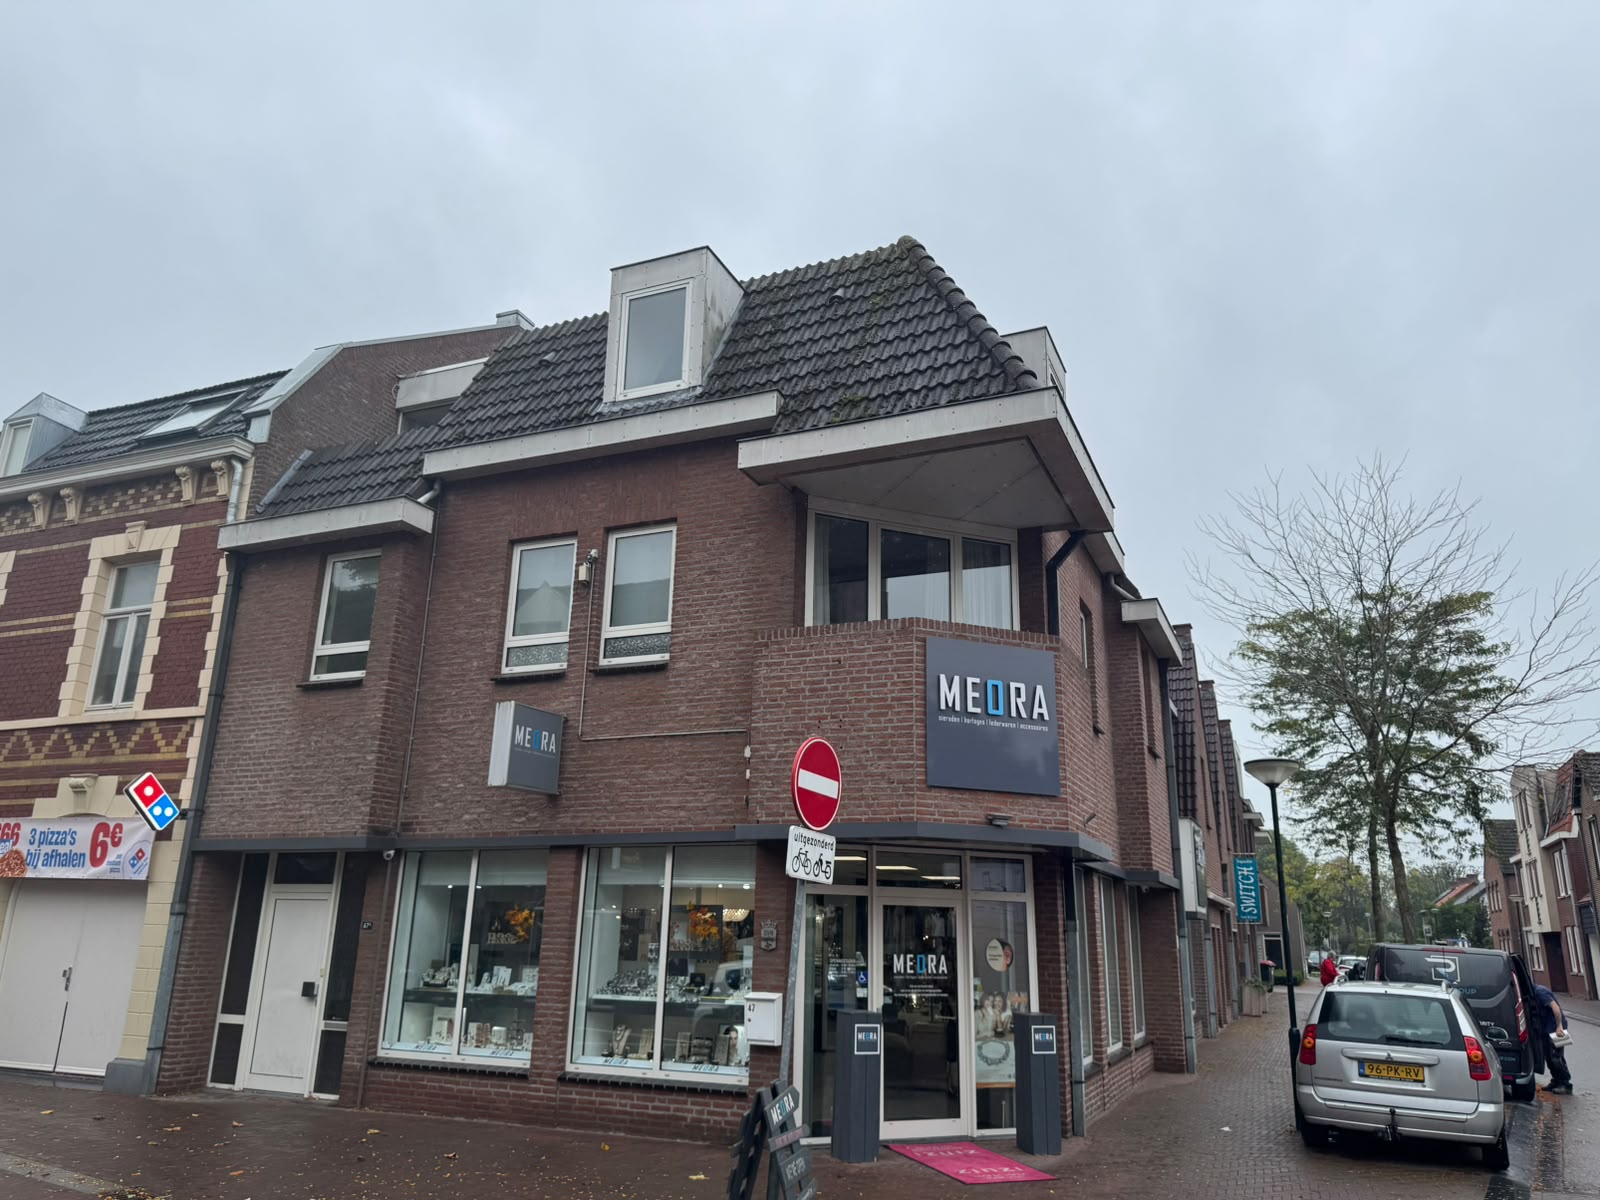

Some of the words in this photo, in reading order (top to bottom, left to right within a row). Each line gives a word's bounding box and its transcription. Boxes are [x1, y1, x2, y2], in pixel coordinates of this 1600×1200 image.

[938, 673, 1050, 721] MEORA
[514, 724, 556, 753] MEORA
[29, 827, 37, 846] 3
[38, 827, 77, 848] pizza's
[793, 832, 835, 851] uitgezonderd
[25, 849, 41, 869] bij
[41, 849, 87, 868] afhalen
[1236, 866, 1258, 914] SWITCH
[893, 953, 949, 974] MEORA
[747, 1003, 756, 1013] 47
[1366, 1063, 1421, 1079] 96-PK-RV
[770, 1092, 796, 1126] MEORA
